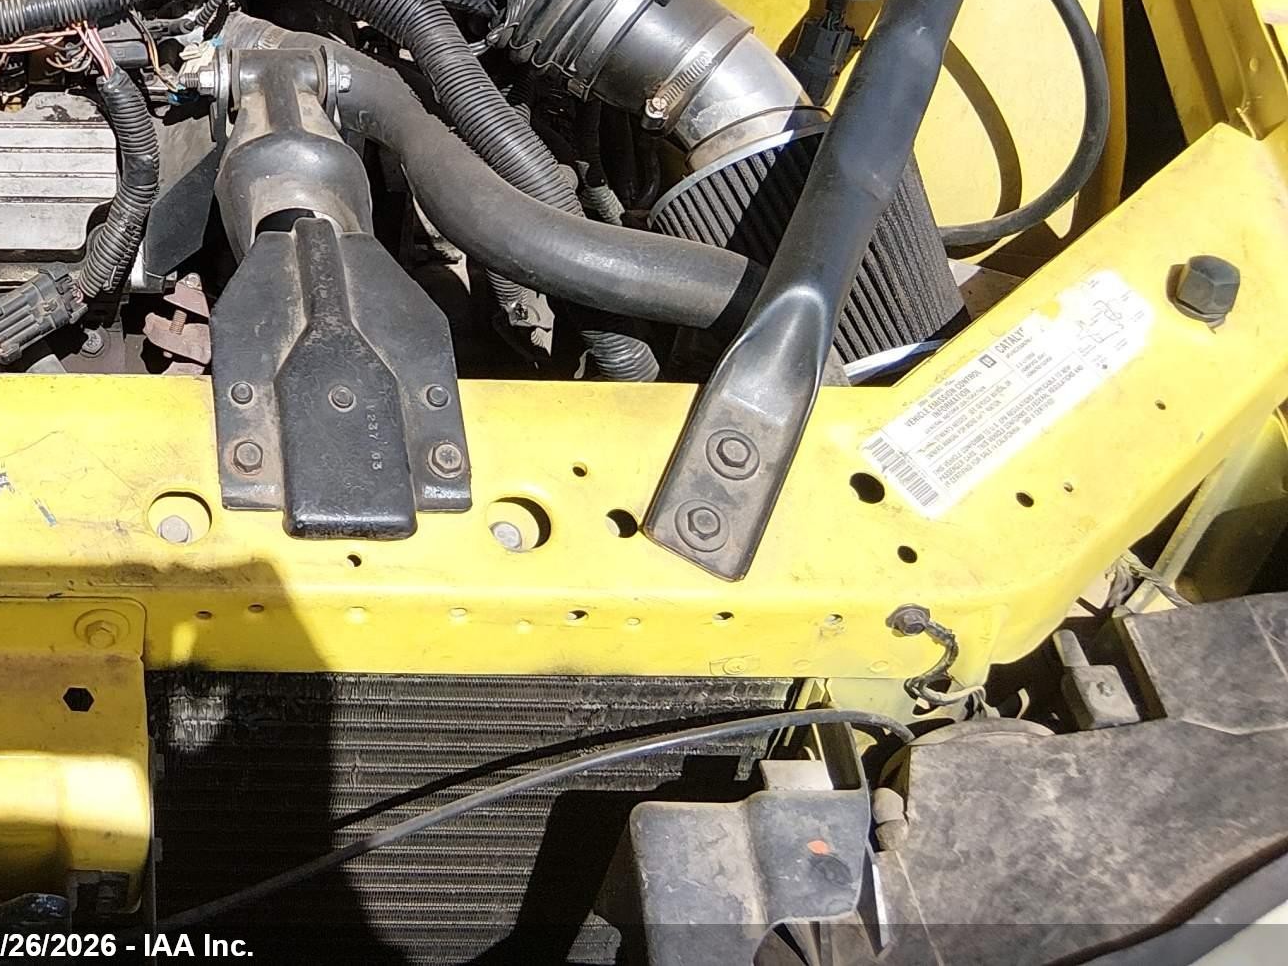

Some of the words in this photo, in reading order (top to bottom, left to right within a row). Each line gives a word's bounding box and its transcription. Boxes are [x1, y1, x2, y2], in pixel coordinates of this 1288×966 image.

[904, 406, 930, 427] VEHICLE
[927, 386, 956, 410] EMISSION
[954, 368, 981, 390] CONTROL
[931, 386, 970, 418] INFORMATION
